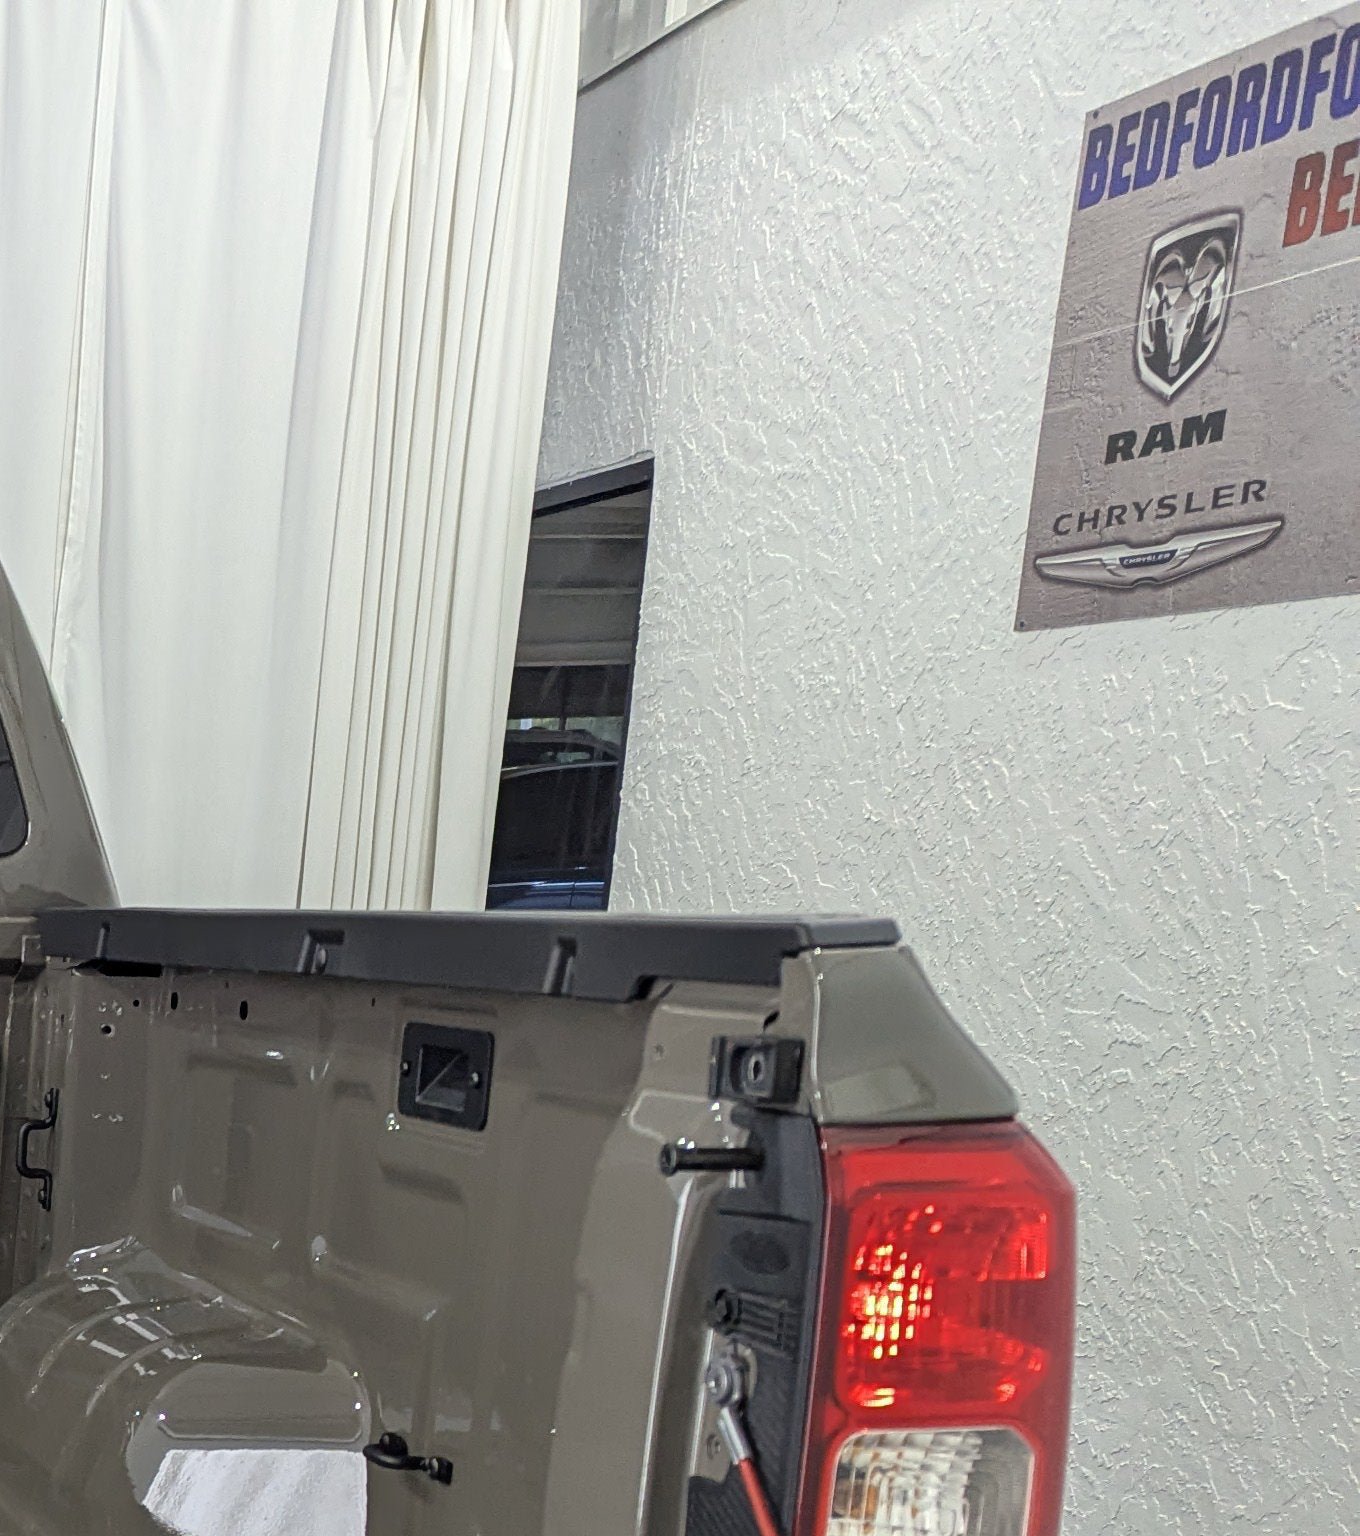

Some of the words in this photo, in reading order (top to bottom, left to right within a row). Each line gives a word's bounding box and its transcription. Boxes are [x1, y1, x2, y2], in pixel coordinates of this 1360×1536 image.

[1282, 138, 1360, 248] BE
[1104, 408, 1227, 465] RAM
[1052, 479, 1267, 536] CHRYSLER
